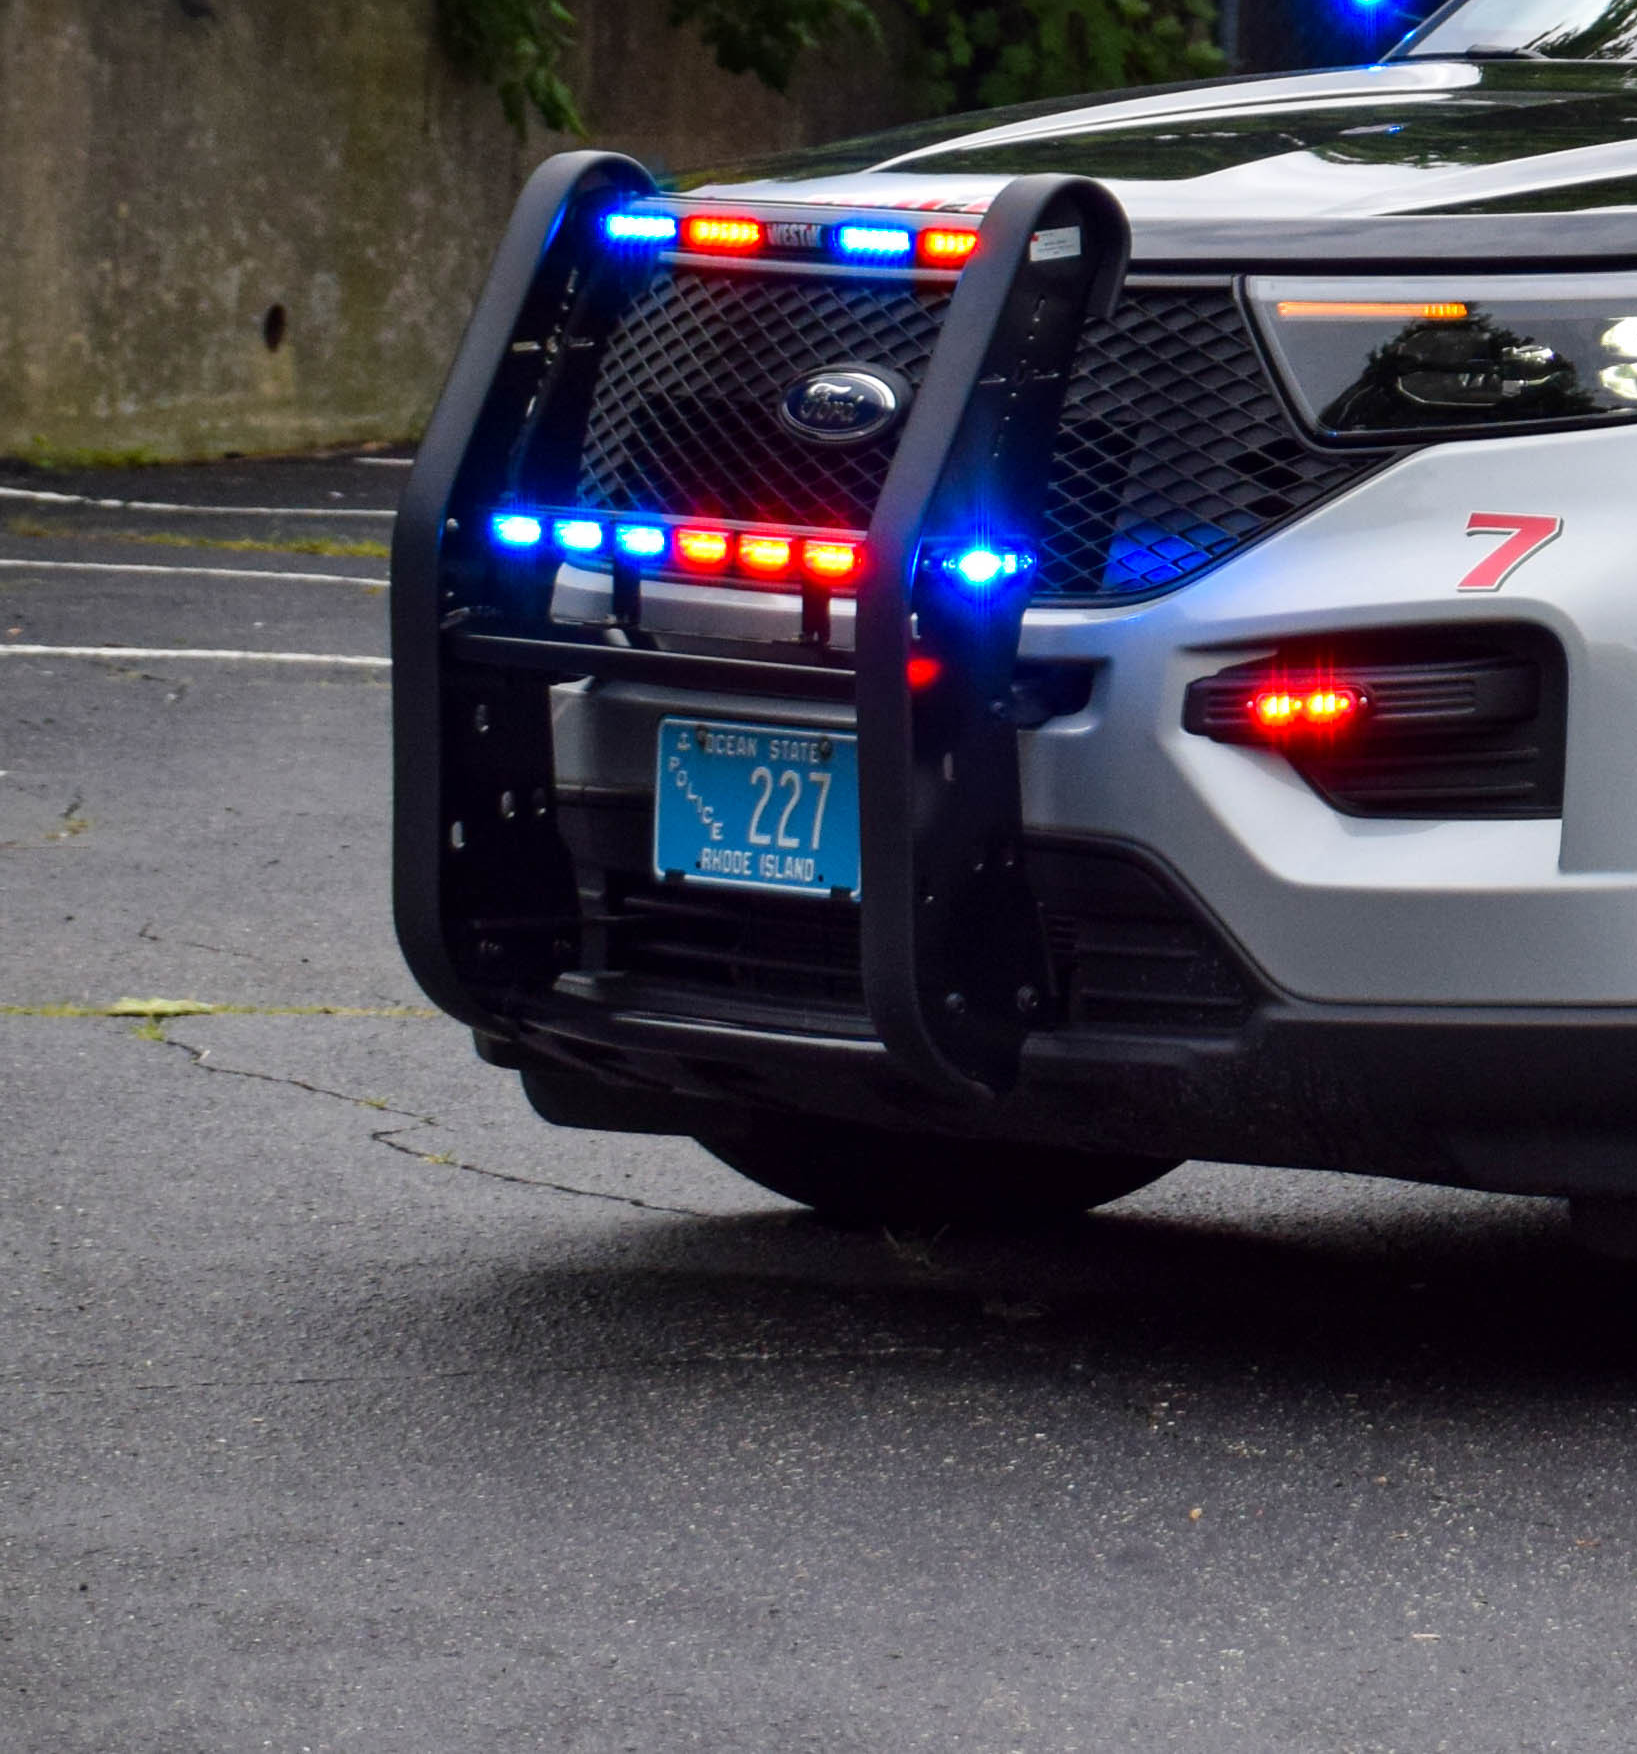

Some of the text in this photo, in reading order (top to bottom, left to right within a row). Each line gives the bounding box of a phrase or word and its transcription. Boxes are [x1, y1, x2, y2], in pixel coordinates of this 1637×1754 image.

[1456, 510, 1563, 593] 7
[703, 733, 819, 764] OCEAN STATE
[667, 756, 724, 841] POLICE
[747, 766, 833, 851] 227
[700, 847, 815, 883] RHODE ISLAND
